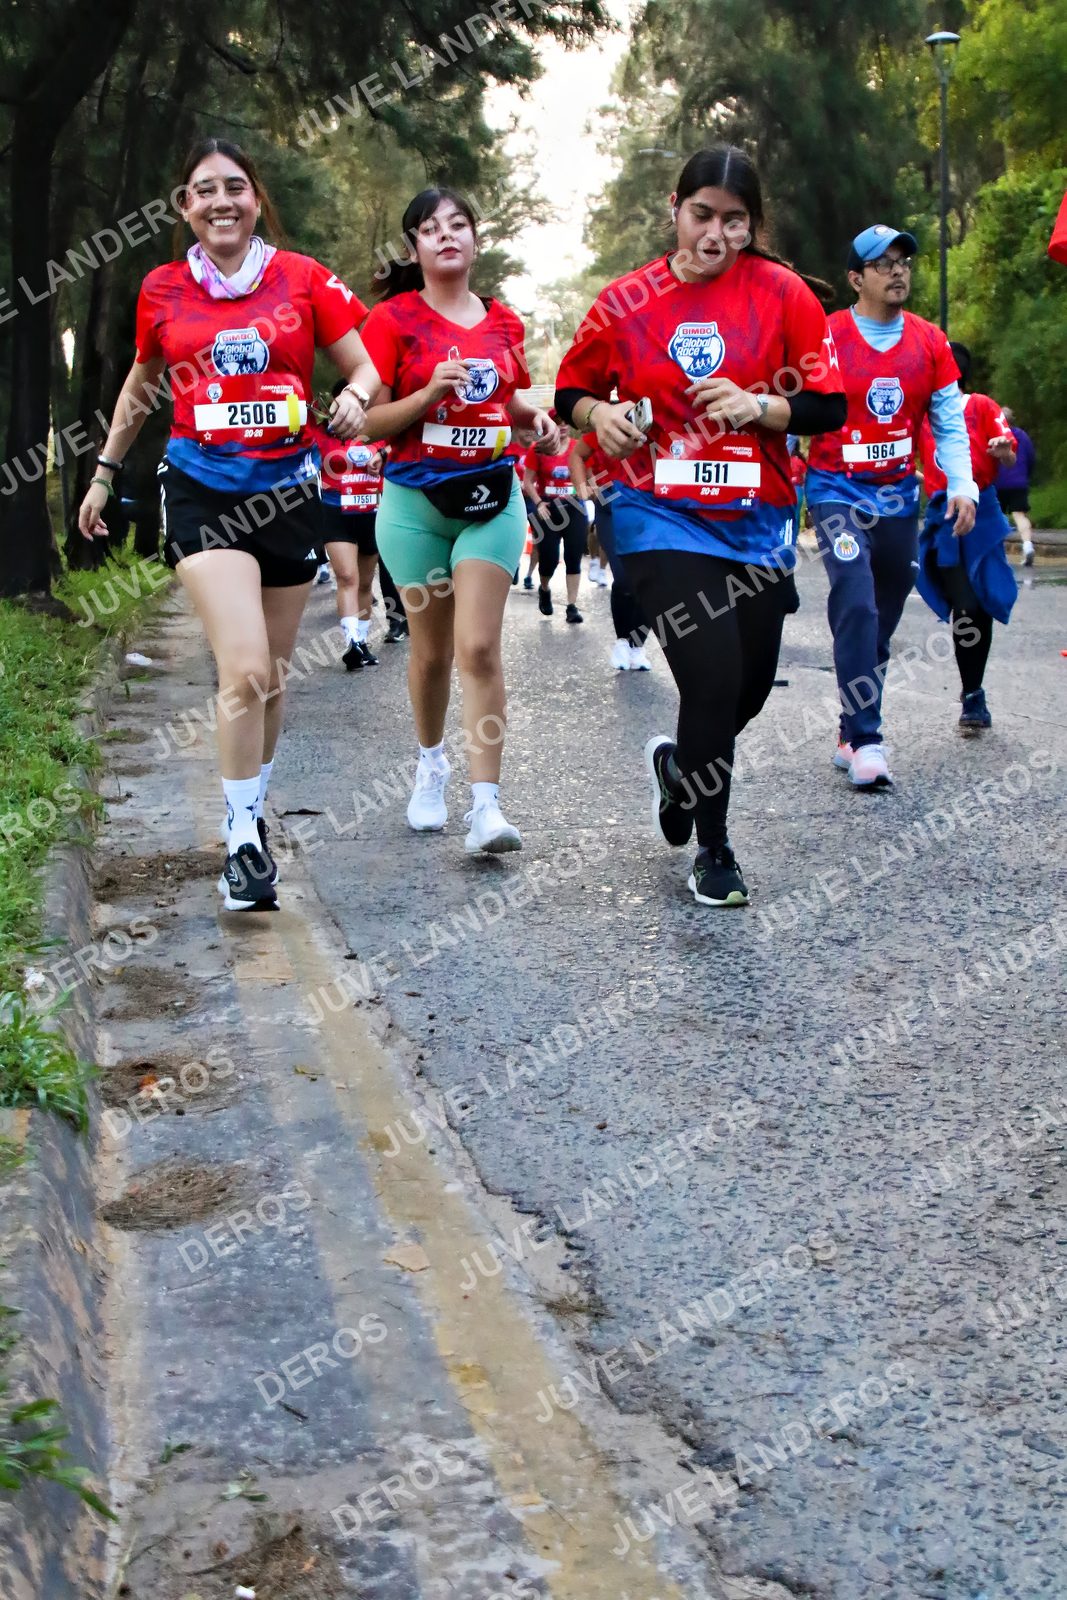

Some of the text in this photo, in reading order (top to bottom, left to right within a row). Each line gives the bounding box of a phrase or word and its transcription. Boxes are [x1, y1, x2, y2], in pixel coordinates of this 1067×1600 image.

[225, 342, 255, 353] Global
[682, 337, 711, 347] Global
[676, 346, 700, 356] Race
[221, 353, 244, 363] Race
[228, 403, 277, 426] 2506
[451, 427, 487, 447] 2122
[866, 443, 895, 460] 1964
[694, 461, 729, 484] 1511
[353, 495, 372, 504] 17551
[464, 500, 499, 512] CONVERSE
